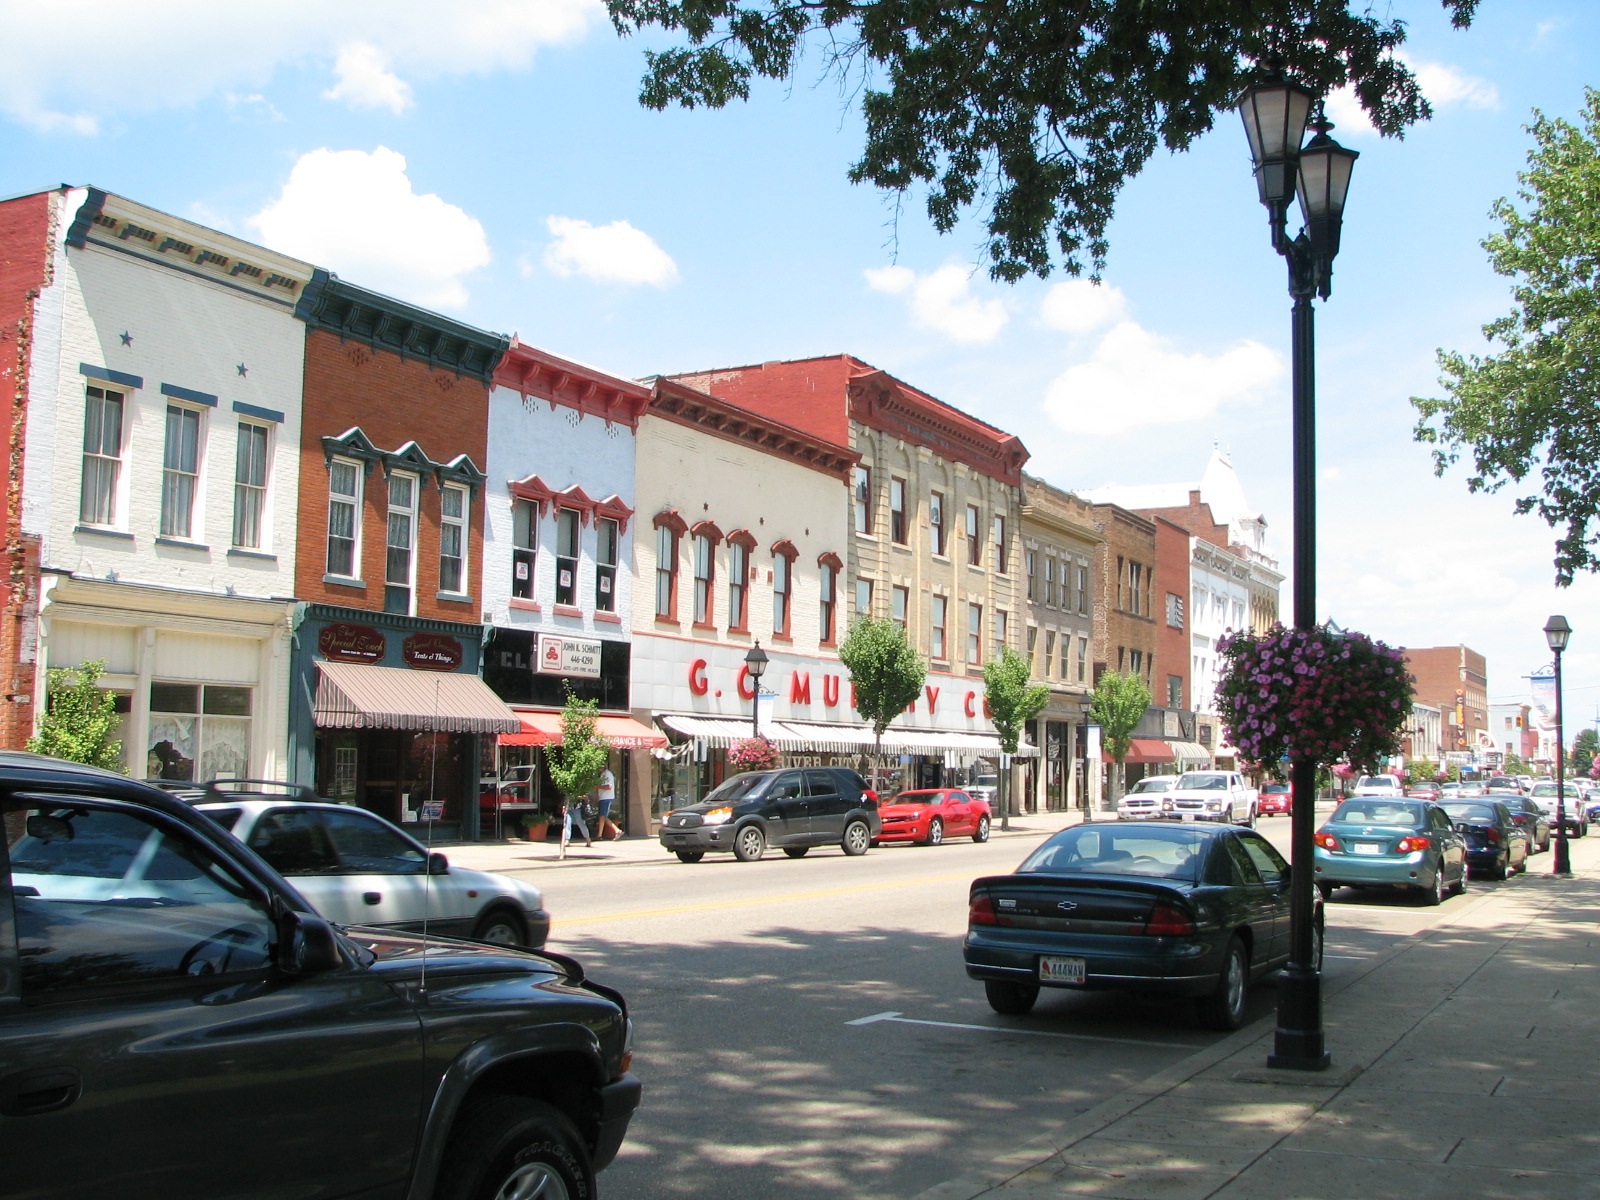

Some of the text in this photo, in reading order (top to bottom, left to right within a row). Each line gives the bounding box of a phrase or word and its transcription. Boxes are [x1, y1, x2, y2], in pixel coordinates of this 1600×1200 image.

[320, 632, 384, 651] Special Touch
[563, 642, 576, 651] JOHN
[582, 644, 601, 654] SCHMITT
[571, 655, 594, 665] 446-4290
[789, 670, 940, 715] MUY
[776, 755, 822, 770] RIVER
[829, 756, 863, 770] CITY
[514, 1141, 587, 1198] TRACKER
